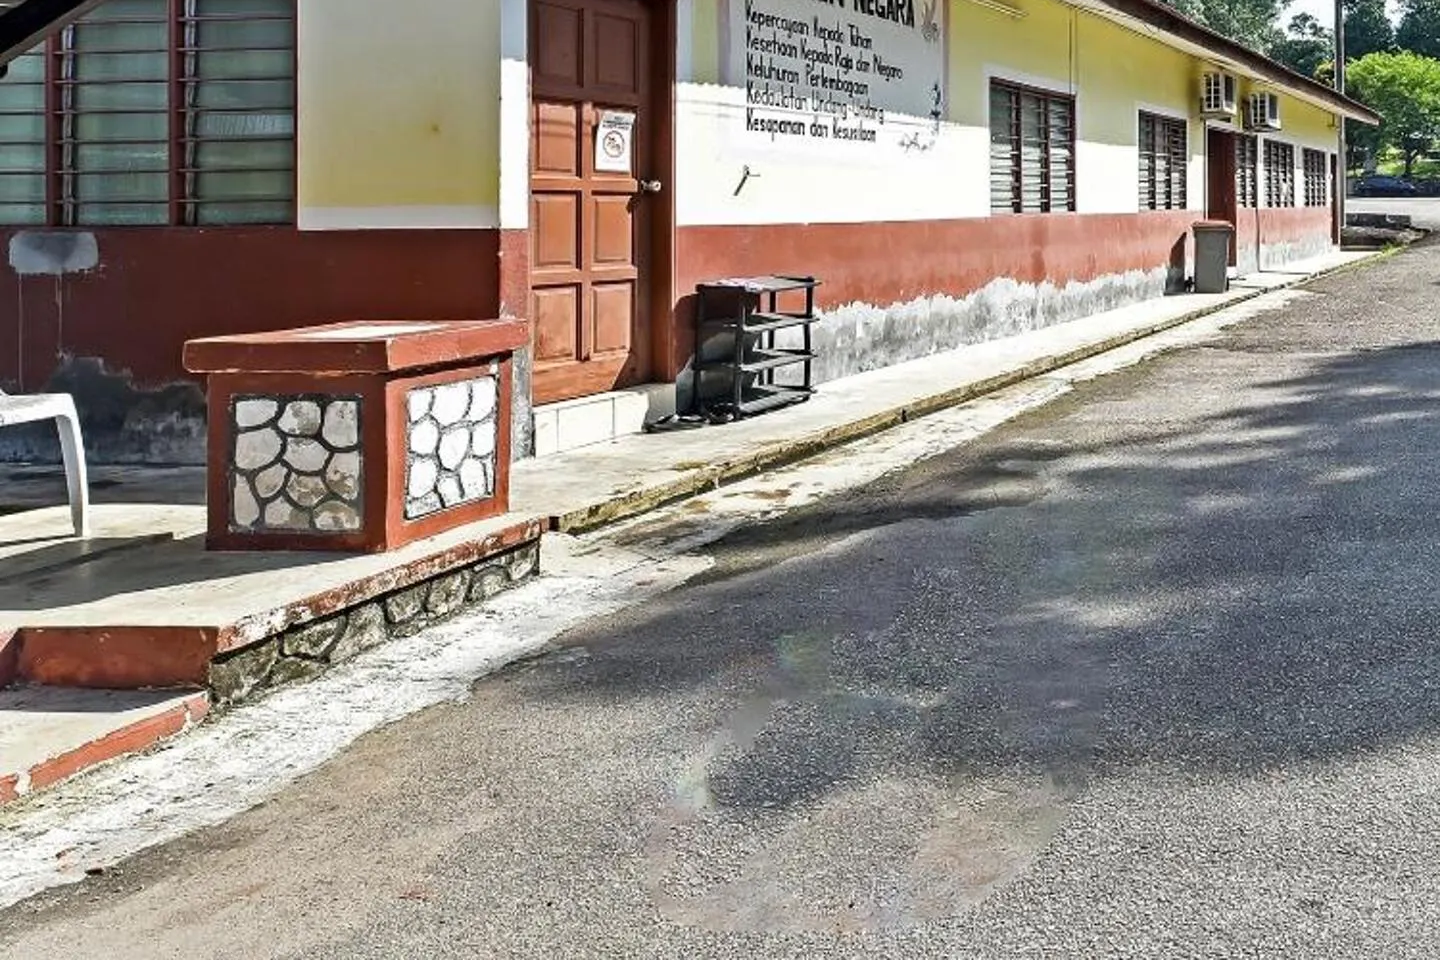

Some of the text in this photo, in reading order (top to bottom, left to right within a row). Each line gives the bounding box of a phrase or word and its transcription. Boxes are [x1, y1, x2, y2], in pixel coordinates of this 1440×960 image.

[813, 15, 844, 44] Kepada
[847, 23, 872, 50] Tuhan
[746, 51, 799, 85] Keluhuran
[801, 38, 834, 68] Kepada
[835, 45, 853, 75] Raja
[856, 50, 870, 72] dan
[873, 53, 903, 82] Negara
[810, 114, 828, 138] dan
